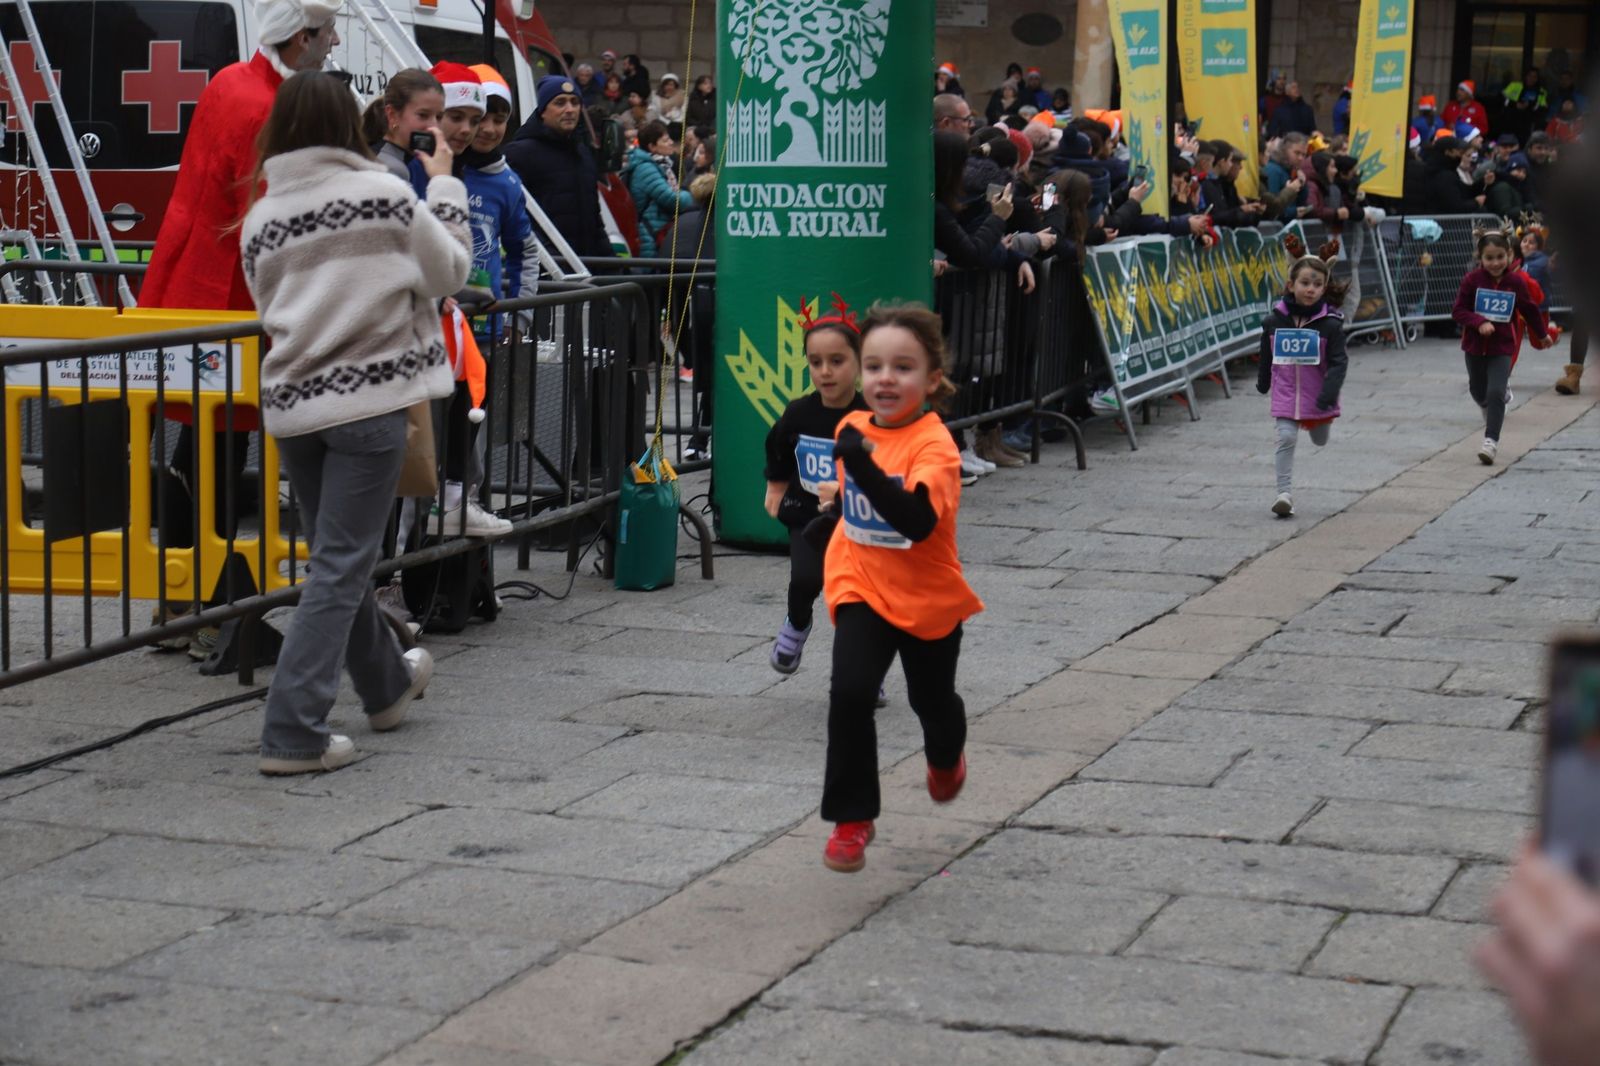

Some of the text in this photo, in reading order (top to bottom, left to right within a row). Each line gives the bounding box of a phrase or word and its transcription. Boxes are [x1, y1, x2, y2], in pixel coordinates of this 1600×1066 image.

[727, 183, 887, 208] FUNDACION
[727, 211, 887, 239] CAJA RURAL
[1483, 297, 1508, 312] 123
[1281, 338, 1310, 353] 037
[76, 360, 122, 371] CSTILL
[60, 371, 117, 380] DELACIÓN
[133, 374, 170, 382] ZAMOA
[806, 453, 833, 479] 05
